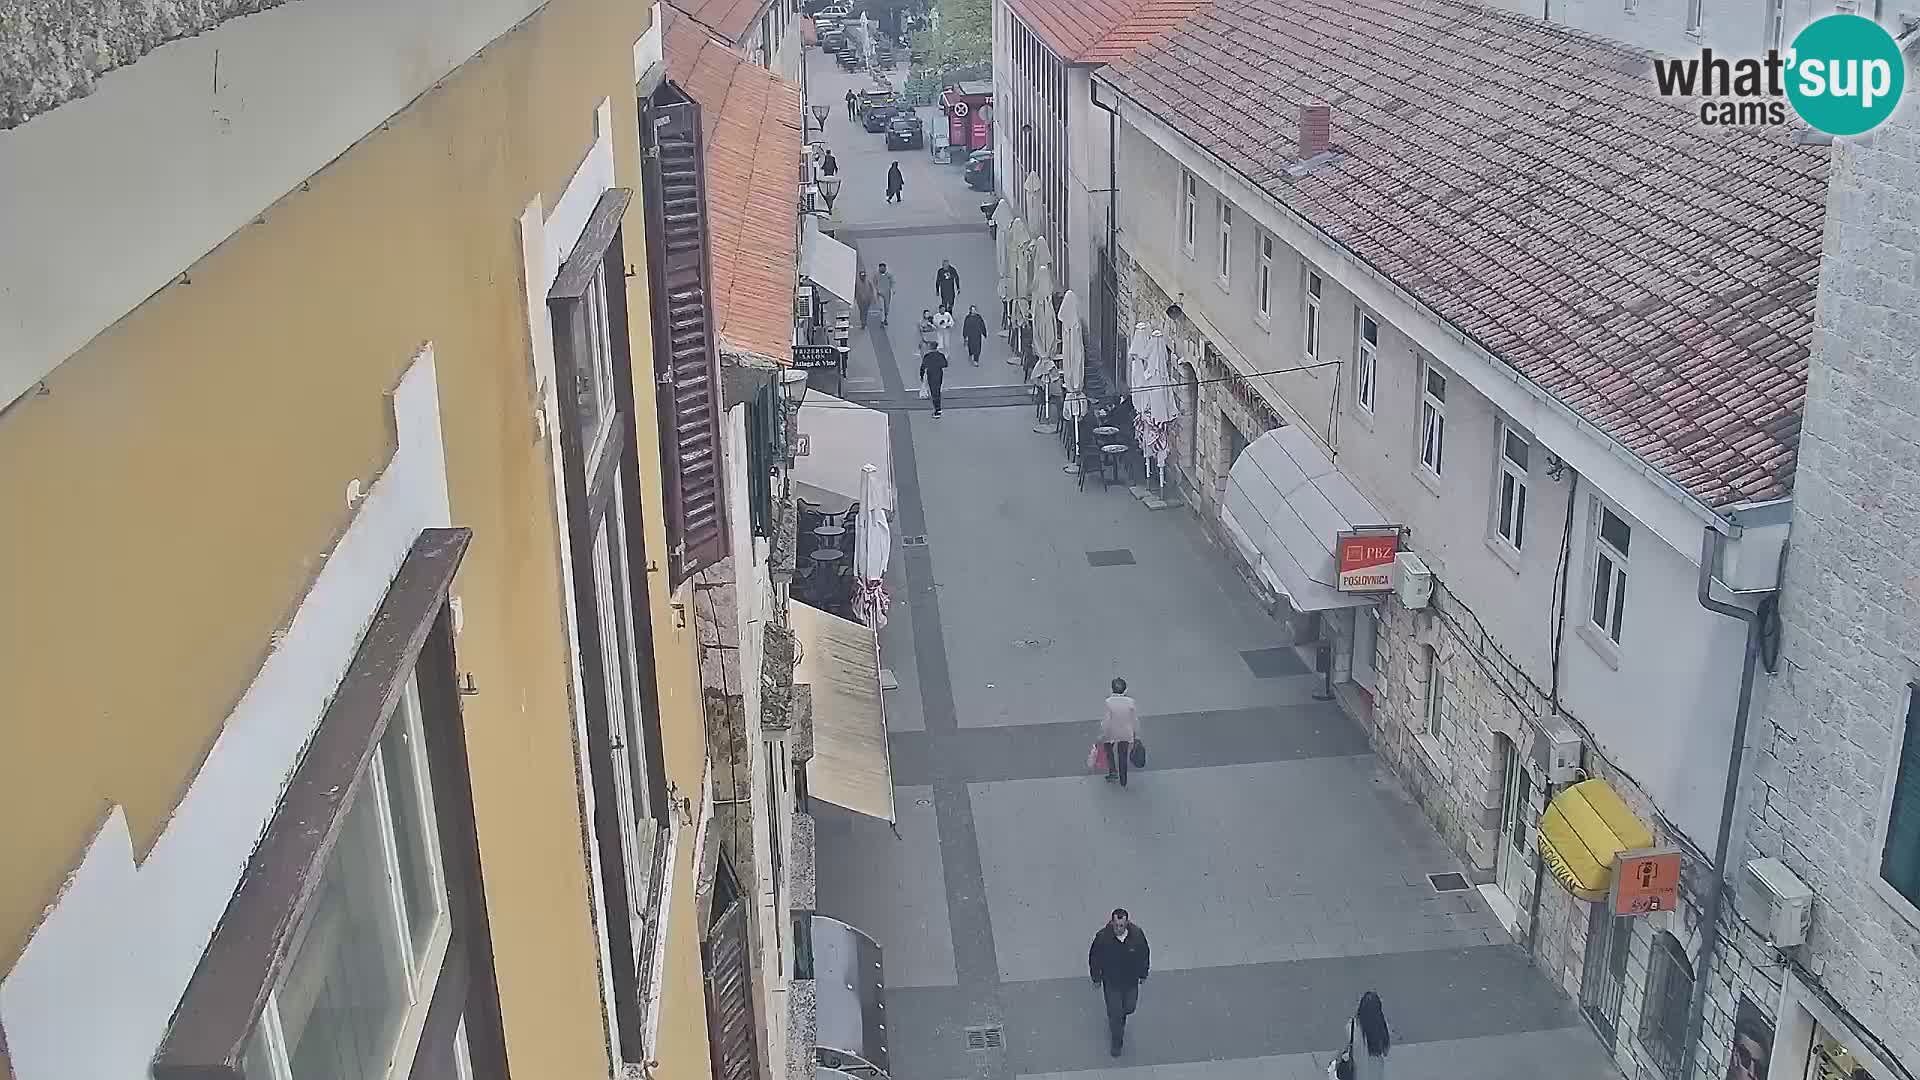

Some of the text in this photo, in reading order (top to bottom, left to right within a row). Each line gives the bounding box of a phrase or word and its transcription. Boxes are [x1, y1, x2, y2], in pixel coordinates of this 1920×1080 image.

[1366, 547, 1392, 559] PBZ
[1344, 576, 1388, 586] POSLOVNICA
[1537, 835, 1577, 890] STUDIO IVAN
